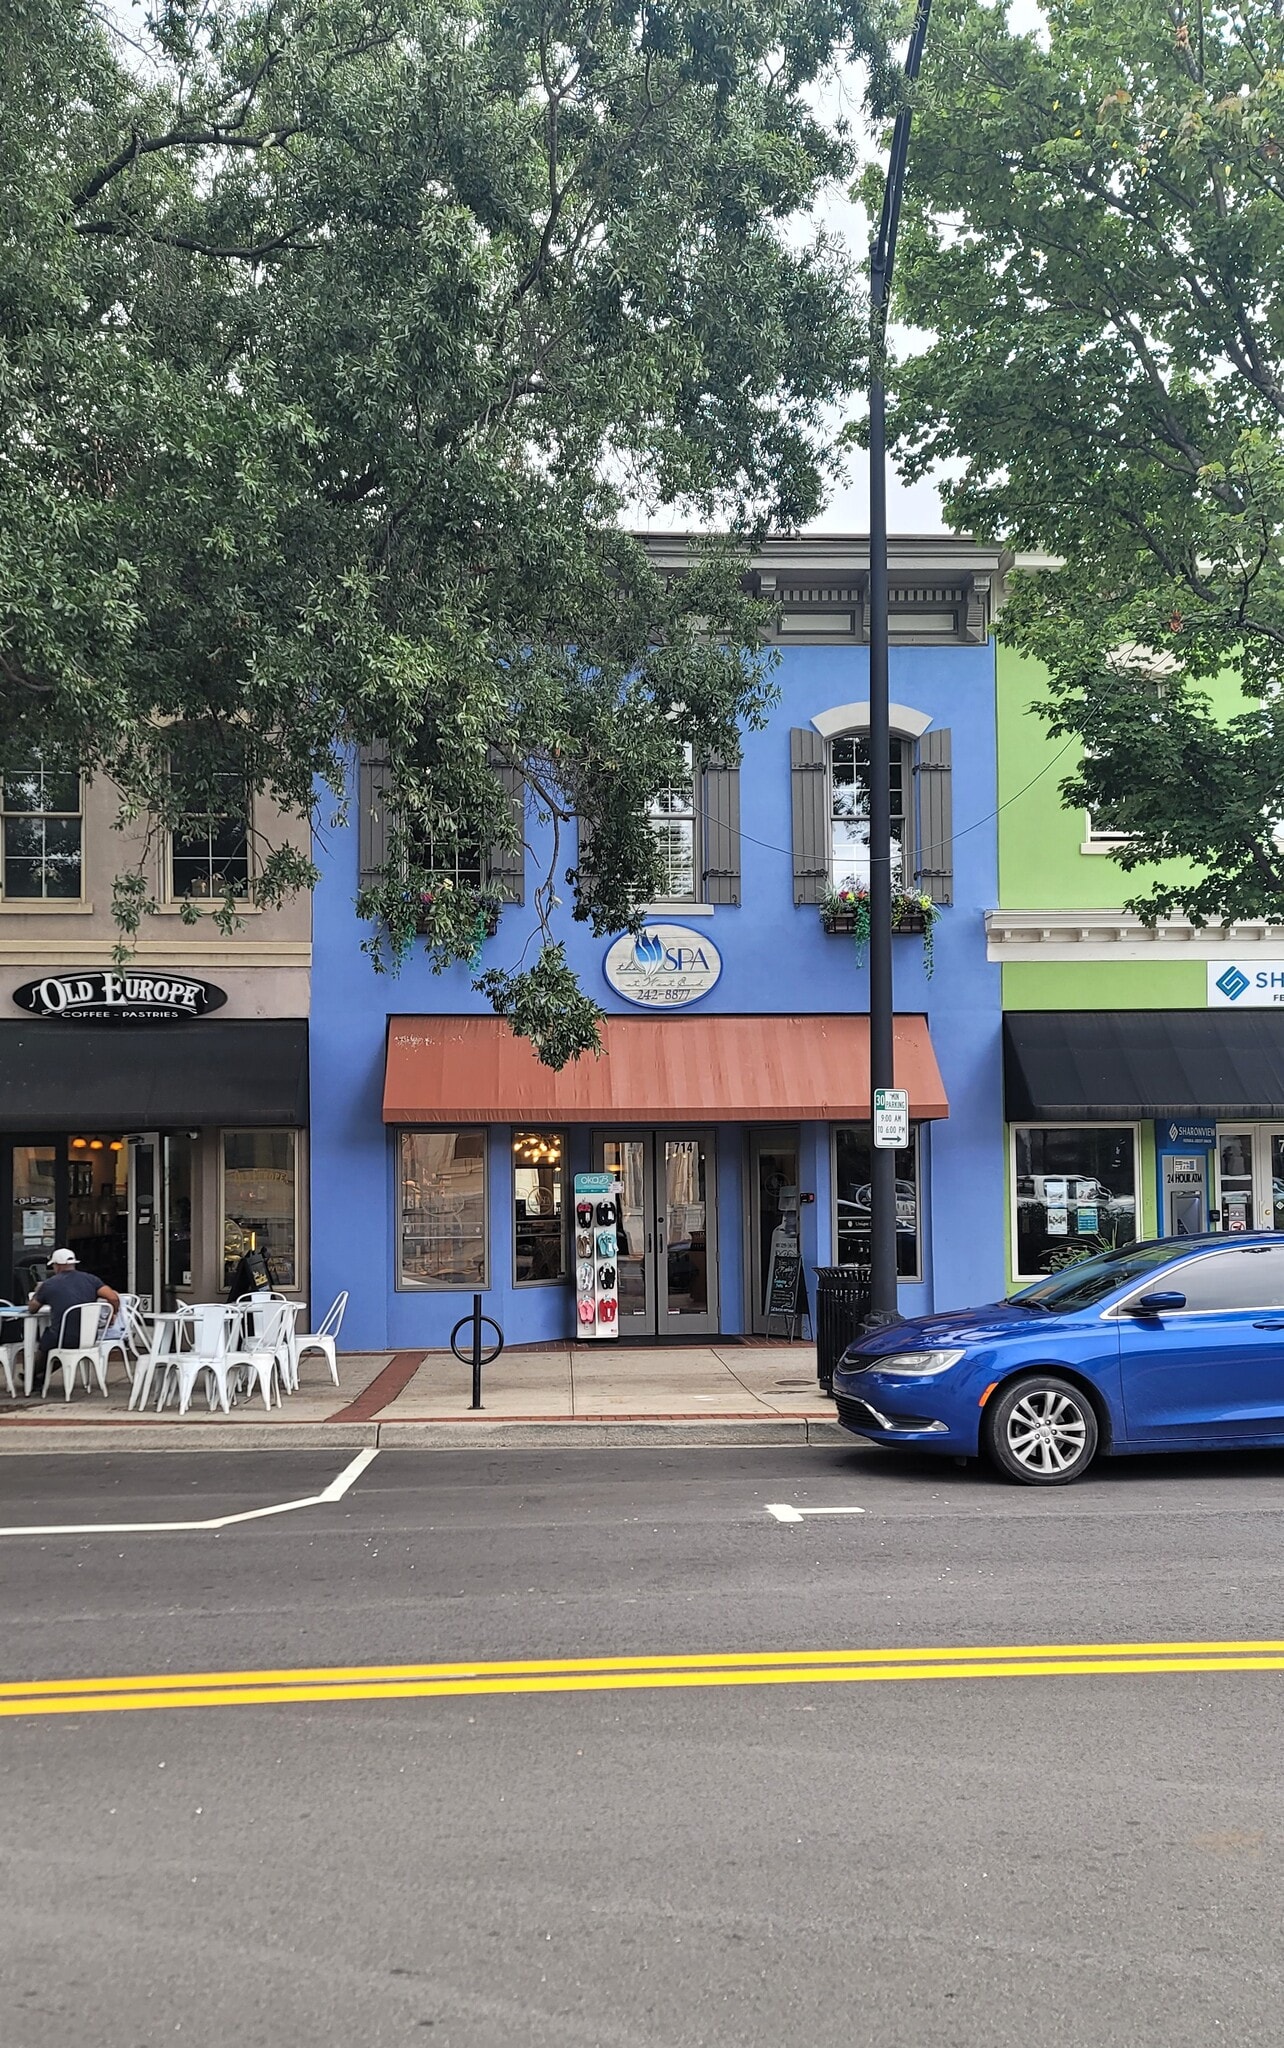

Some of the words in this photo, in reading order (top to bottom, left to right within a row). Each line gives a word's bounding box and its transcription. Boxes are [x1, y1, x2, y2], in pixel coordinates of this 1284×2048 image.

[663, 947, 709, 971] SPA
[1256, 972, 1284, 988] SH
[637, 988, 691, 1001] 242-8877
[876, 1094, 885, 1106] 30
[885, 1101, 905, 1109] PARKING
[881, 1114, 892, 1122] 9:00
[894, 1114, 902, 1122] AM
[877, 1125, 884, 1133] TO
[886, 1125, 897, 1133] 6:00
[899, 1126, 906, 1134] PM
[1179, 1126, 1216, 1136] SHARONVIEW
[675, 1142, 693, 1153] 714
[1167, 1173, 1174, 1184] 24
[1175, 1173, 1191, 1183] HOUR
[1192, 1173, 1202, 1183] ATM
